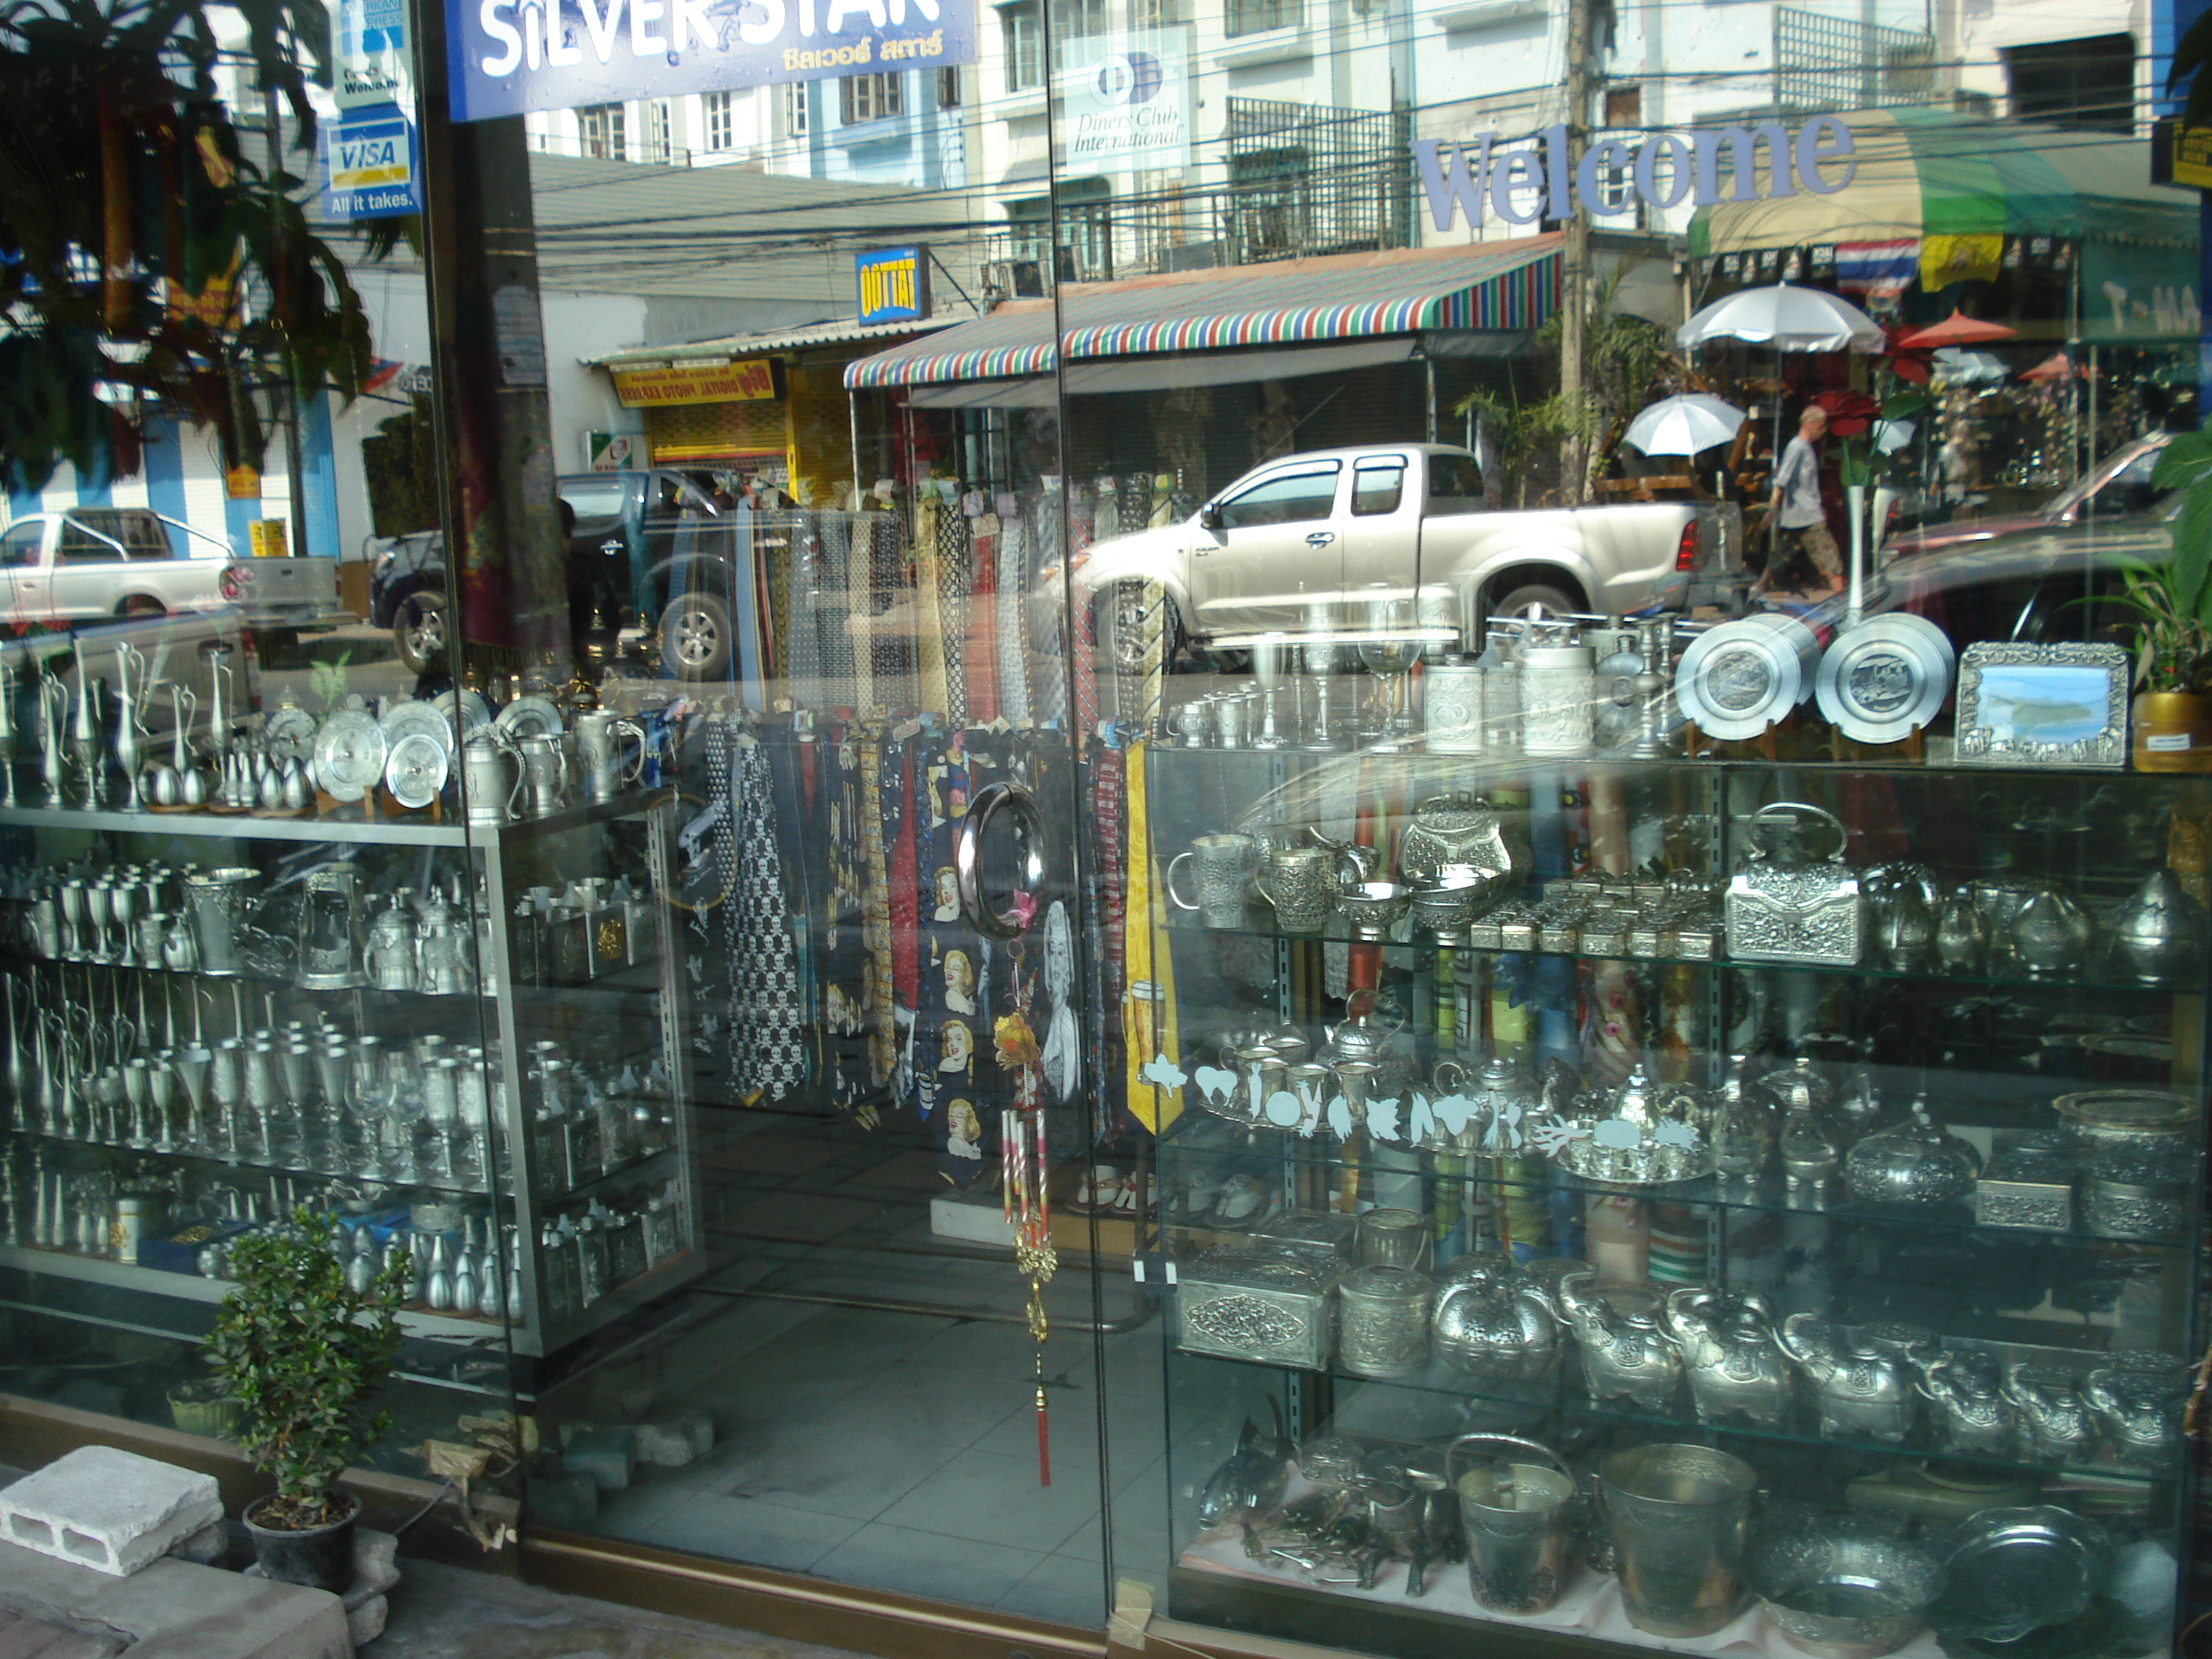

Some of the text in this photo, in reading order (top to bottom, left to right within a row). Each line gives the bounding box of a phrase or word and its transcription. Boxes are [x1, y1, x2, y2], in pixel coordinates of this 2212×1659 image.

[341, 0, 397, 14] ARICAN
[344, 79, 400, 95] Welom
[1079, 104, 1178, 132] Diners Club
[1074, 125, 1182, 153] International
[340, 140, 395, 169] VISA
[1410, 115, 1857, 232] Welcome
[332, 192, 413, 214] All it takes.
